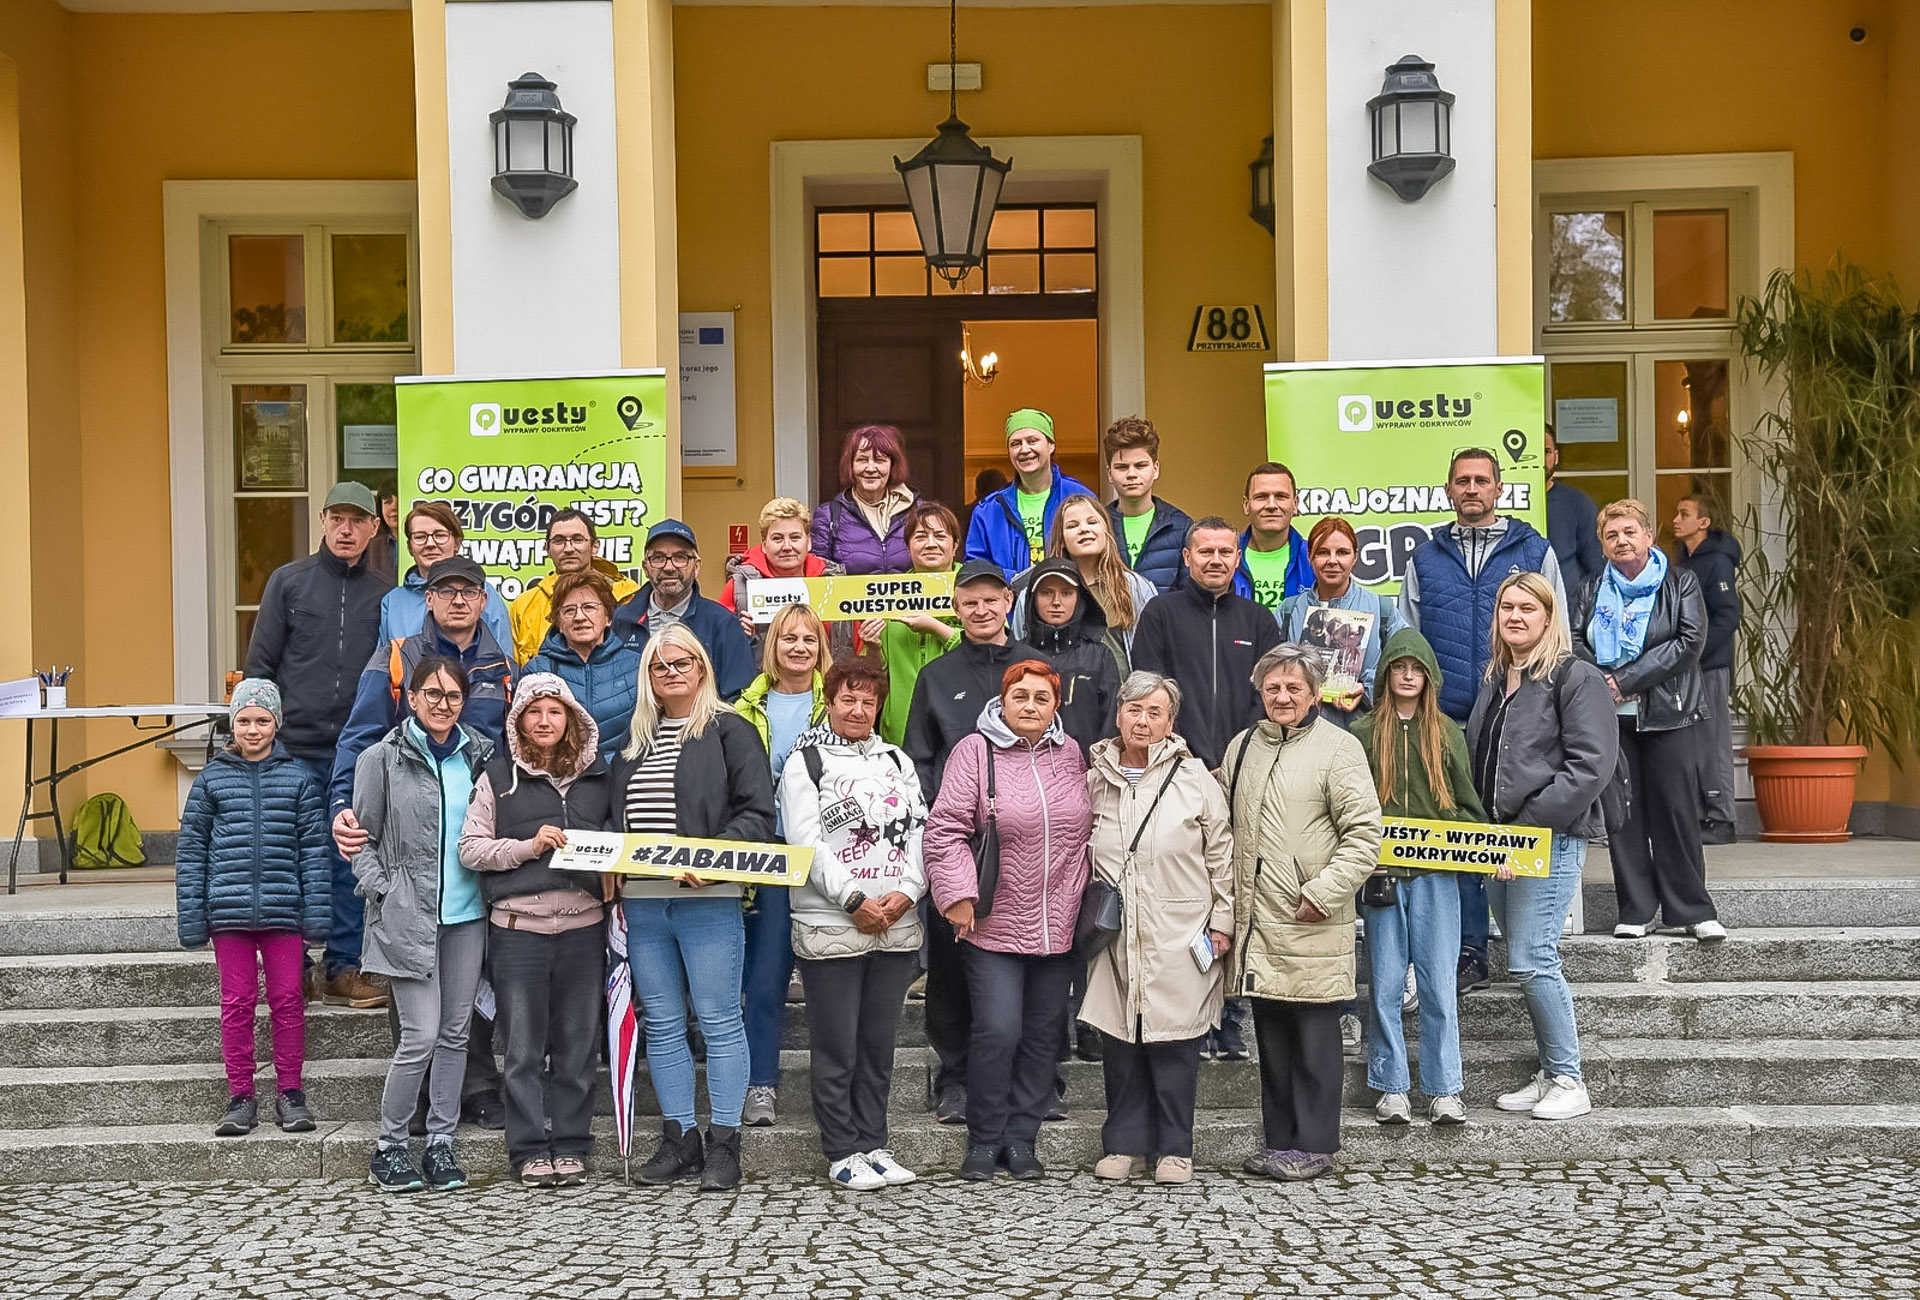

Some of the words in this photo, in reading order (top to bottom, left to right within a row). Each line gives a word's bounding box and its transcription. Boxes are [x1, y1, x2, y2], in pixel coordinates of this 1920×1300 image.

[1207, 307, 1251, 340] 88
[542, 425, 586, 433] ODKRYWCÓW
[1376, 421, 1417, 429] WYPRAWY
[1419, 419, 1472, 428] ODKRYWCÓW
[418, 466, 455, 493] CO
[458, 461, 643, 495] GWARANCJĄ
[1296, 483, 1531, 515] KRAJOZNAZE
[412, 494, 558, 531] ZYGÓD
[866, 580, 922, 596] SUPER
[839, 596, 951, 614] QUESTOWICZ
[1446, 830, 1538, 850] WYPRAWY
[631, 845, 788, 874] #ZABAWA
[1393, 846, 1506, 865] ODKRYWCÓW
